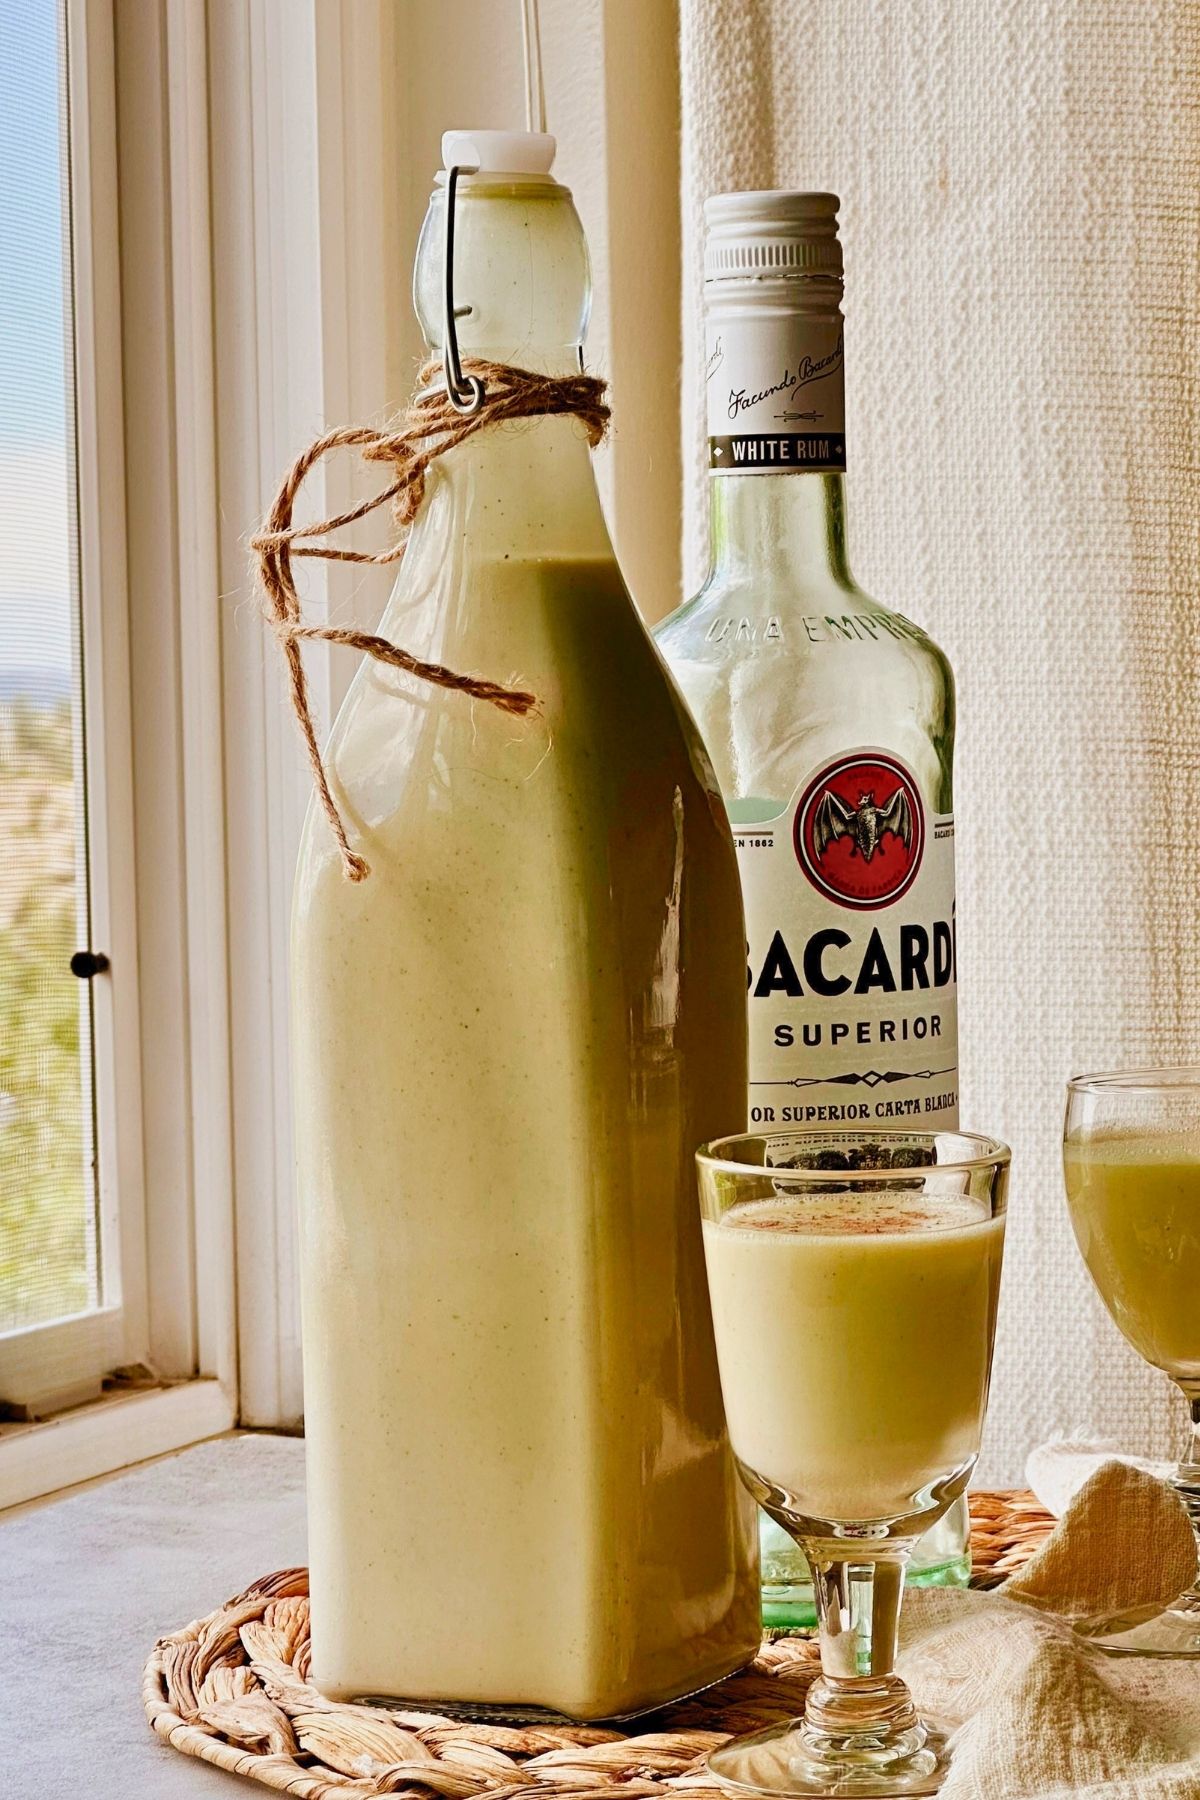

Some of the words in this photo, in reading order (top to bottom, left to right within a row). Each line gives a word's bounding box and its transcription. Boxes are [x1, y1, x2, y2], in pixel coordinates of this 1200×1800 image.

[728, 370, 797, 419] Facundo
[732, 440, 790, 461] WHITE
[797, 439, 829, 460] RUM
[749, 839, 774, 848] 1862
[774, 1014, 942, 1047] SUPERIOR
[782, 1103, 871, 1122] SUPERIOR
[875, 1098, 921, 1118] CARTA
